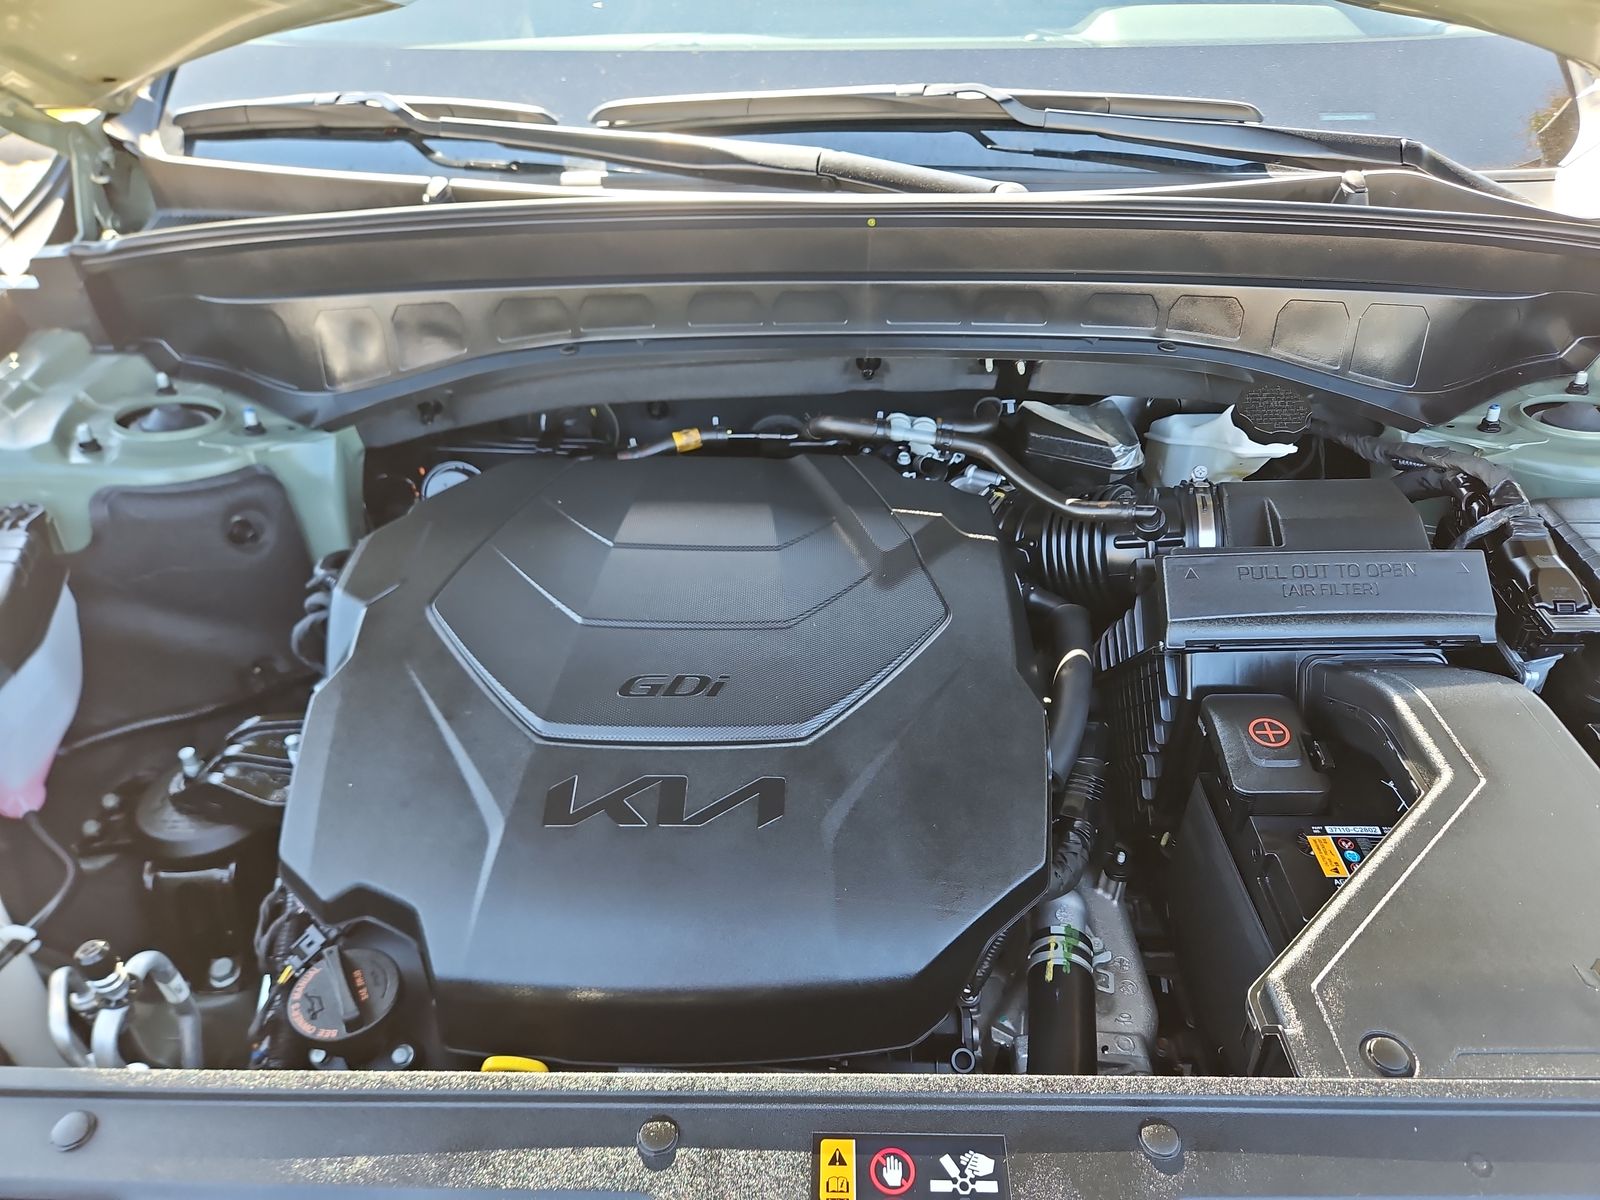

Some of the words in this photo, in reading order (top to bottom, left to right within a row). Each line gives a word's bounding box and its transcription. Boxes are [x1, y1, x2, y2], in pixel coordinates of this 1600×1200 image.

[1237, 565, 1287, 580] PULL
[1292, 563, 1329, 579] OUT
[1334, 563, 1360, 578] TO
[1366, 562, 1417, 578] OPEN
[616, 673, 730, 698] GDi
[543, 774, 787, 829] KIA
